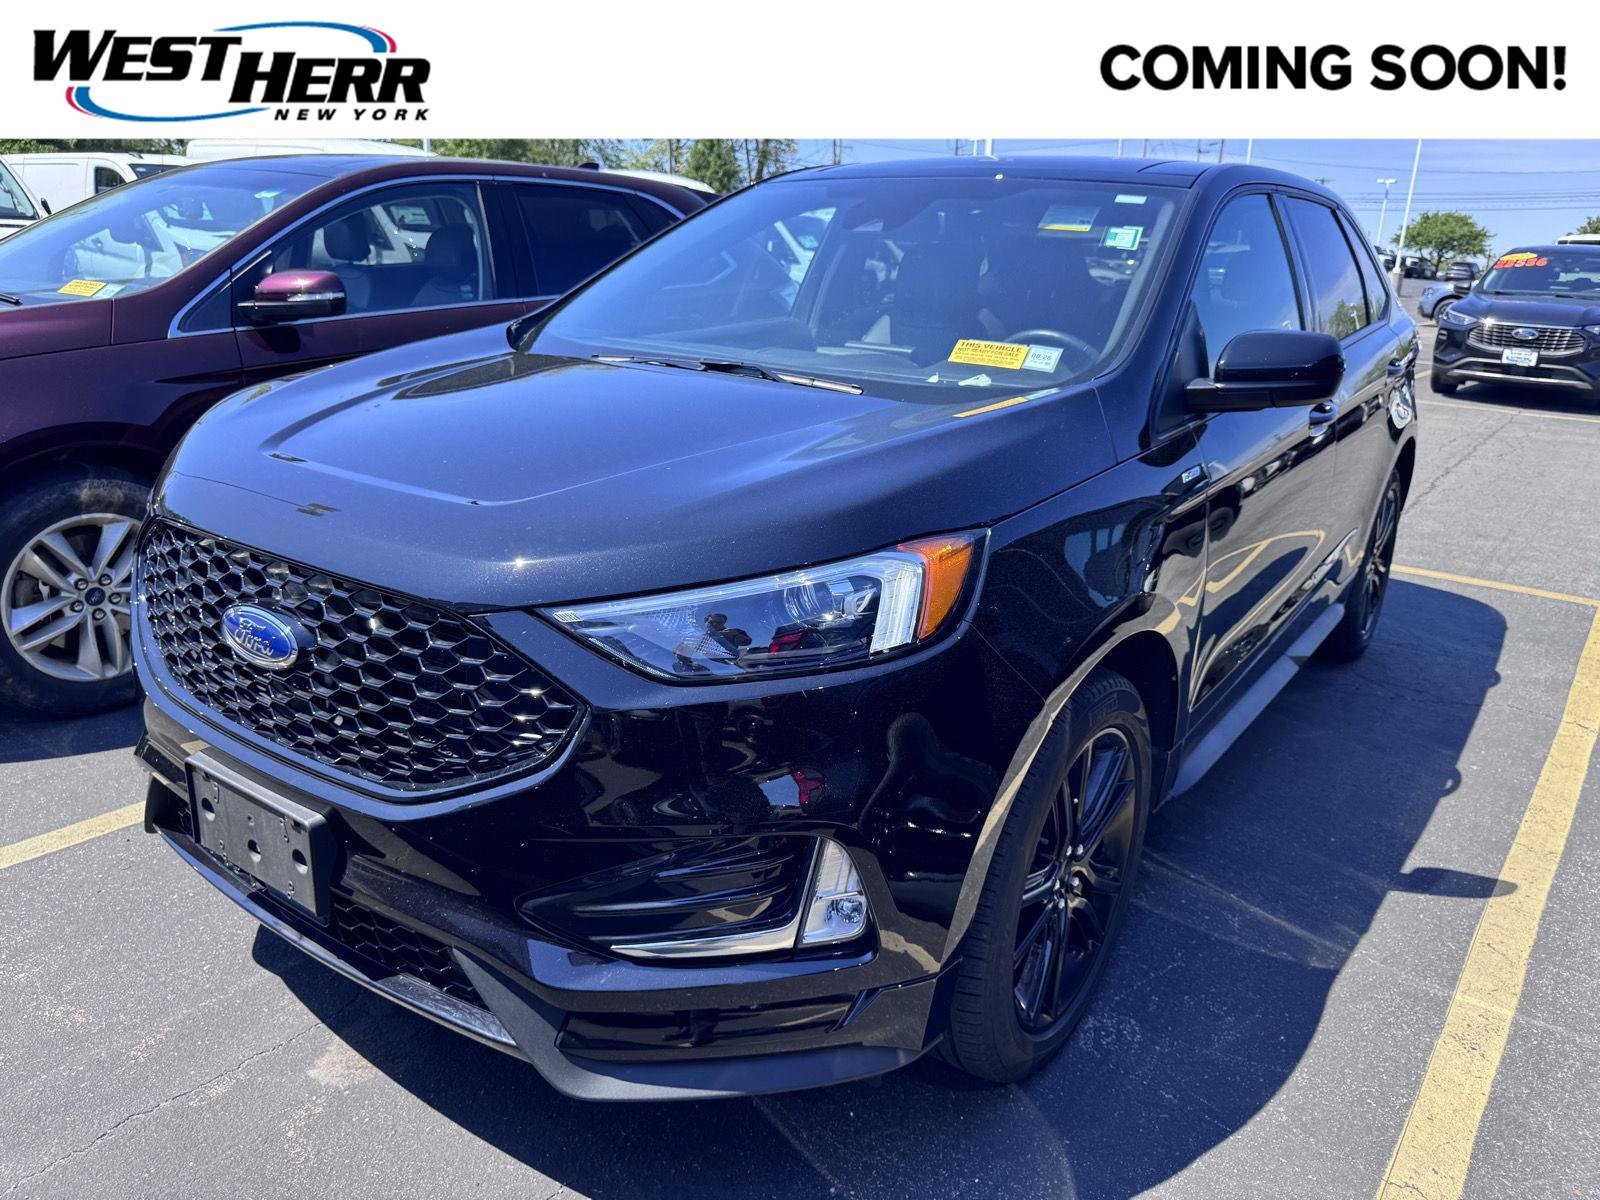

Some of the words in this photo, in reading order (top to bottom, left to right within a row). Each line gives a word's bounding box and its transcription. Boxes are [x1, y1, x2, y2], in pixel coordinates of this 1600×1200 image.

[960, 341, 981, 349] THIS
[984, 344, 1023, 353] VEHICLE
[234, 616, 276, 655] Ford
